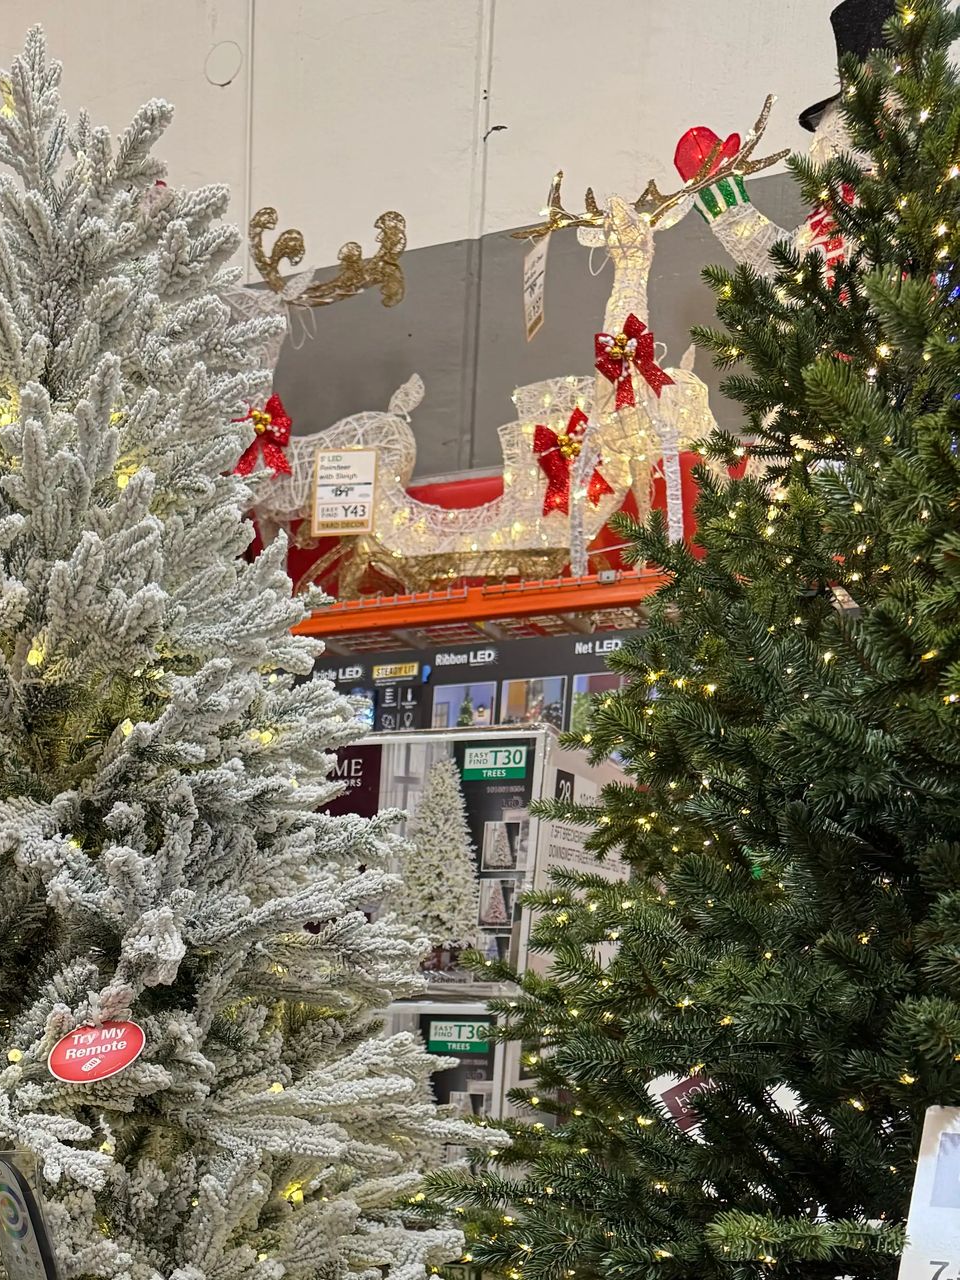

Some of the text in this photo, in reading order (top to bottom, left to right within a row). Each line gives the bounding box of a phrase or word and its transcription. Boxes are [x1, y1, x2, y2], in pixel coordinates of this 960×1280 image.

[342, 504, 366, 517] Y43
[575, 639, 621, 654] Net LED
[435, 650, 495, 666] Ribbon LED
[338, 667, 362, 679] LED
[376, 665, 416, 677] STEADY LIT
[489, 749, 523, 765] T30
[482, 769, 506, 777] TREES
[72, 1027, 126, 1045] Try My
[65, 1040, 127, 1060] Remote
